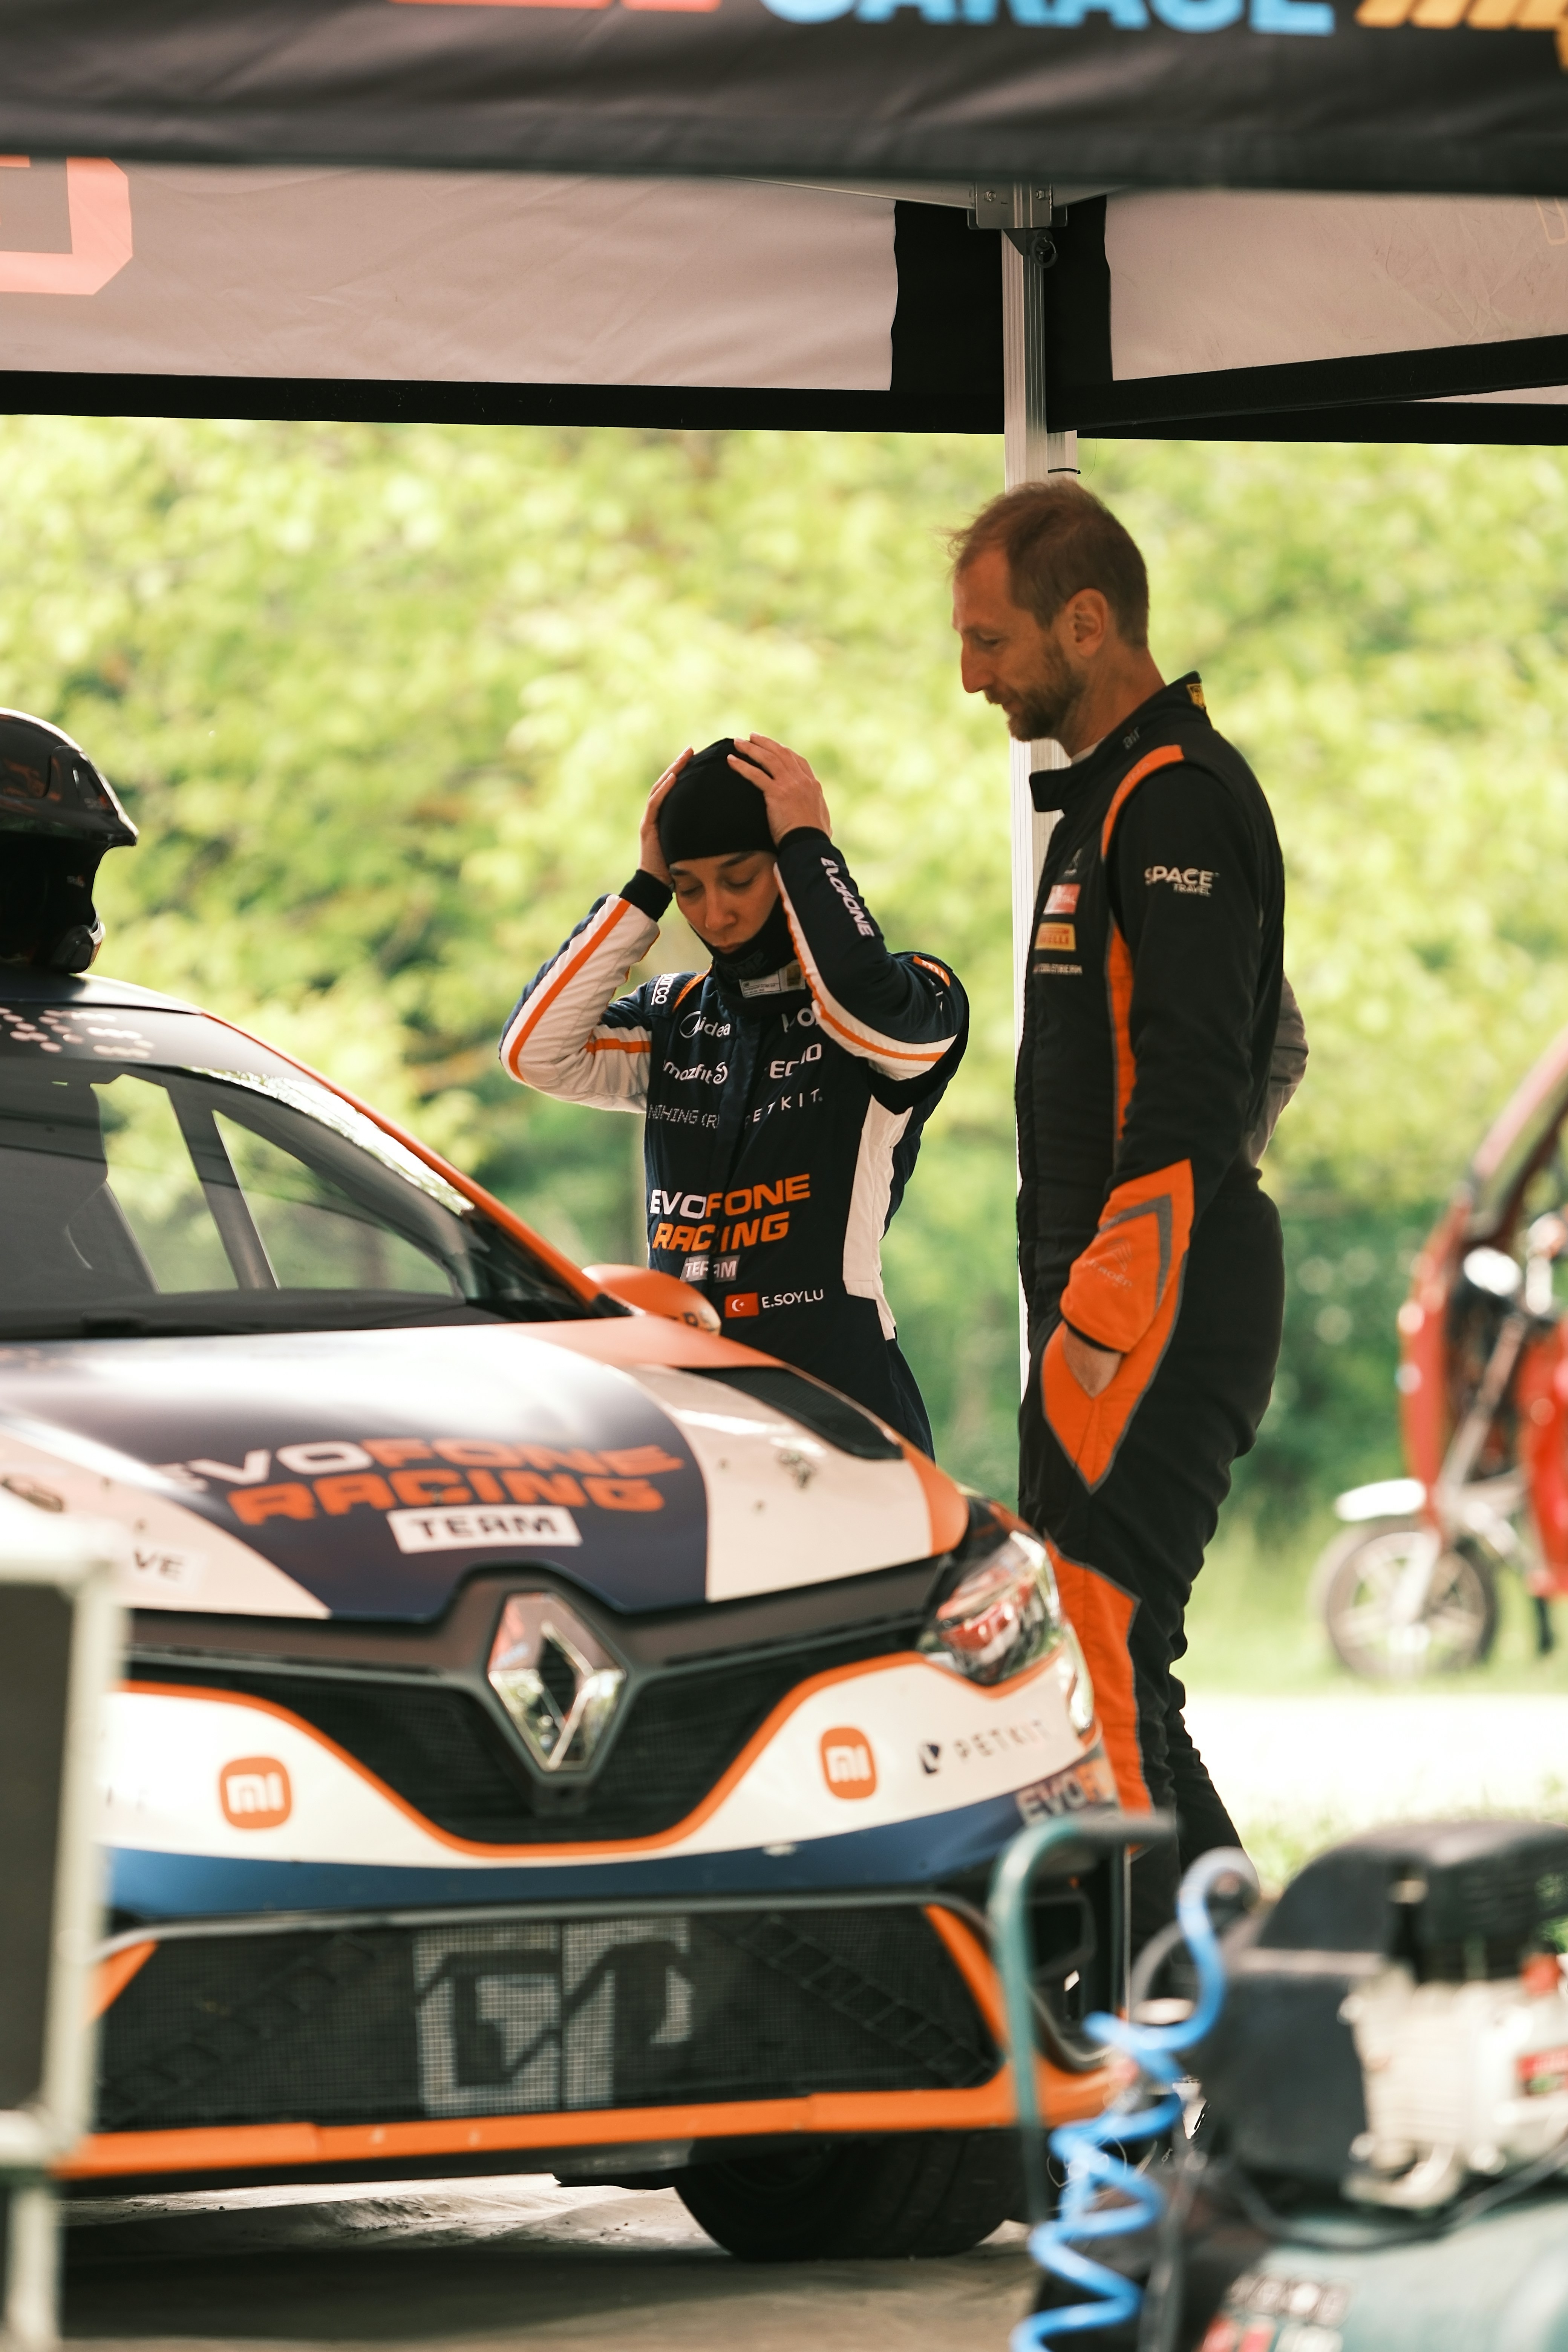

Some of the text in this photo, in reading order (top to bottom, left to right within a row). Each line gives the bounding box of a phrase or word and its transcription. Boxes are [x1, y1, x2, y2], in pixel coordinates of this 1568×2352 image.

[1144, 865, 1214, 890] SPACE
[1173, 883, 1212, 898] TRAVEL
[650, 1173, 811, 1219] EVOFONE
[652, 1211, 790, 1253] RACING
[761, 1288, 824, 1309] E.SOYLU
[155, 1437, 684, 1493] EVOFONE
[228, 1468, 665, 1526] RACING
[409, 1511, 559, 1540] TEAM
